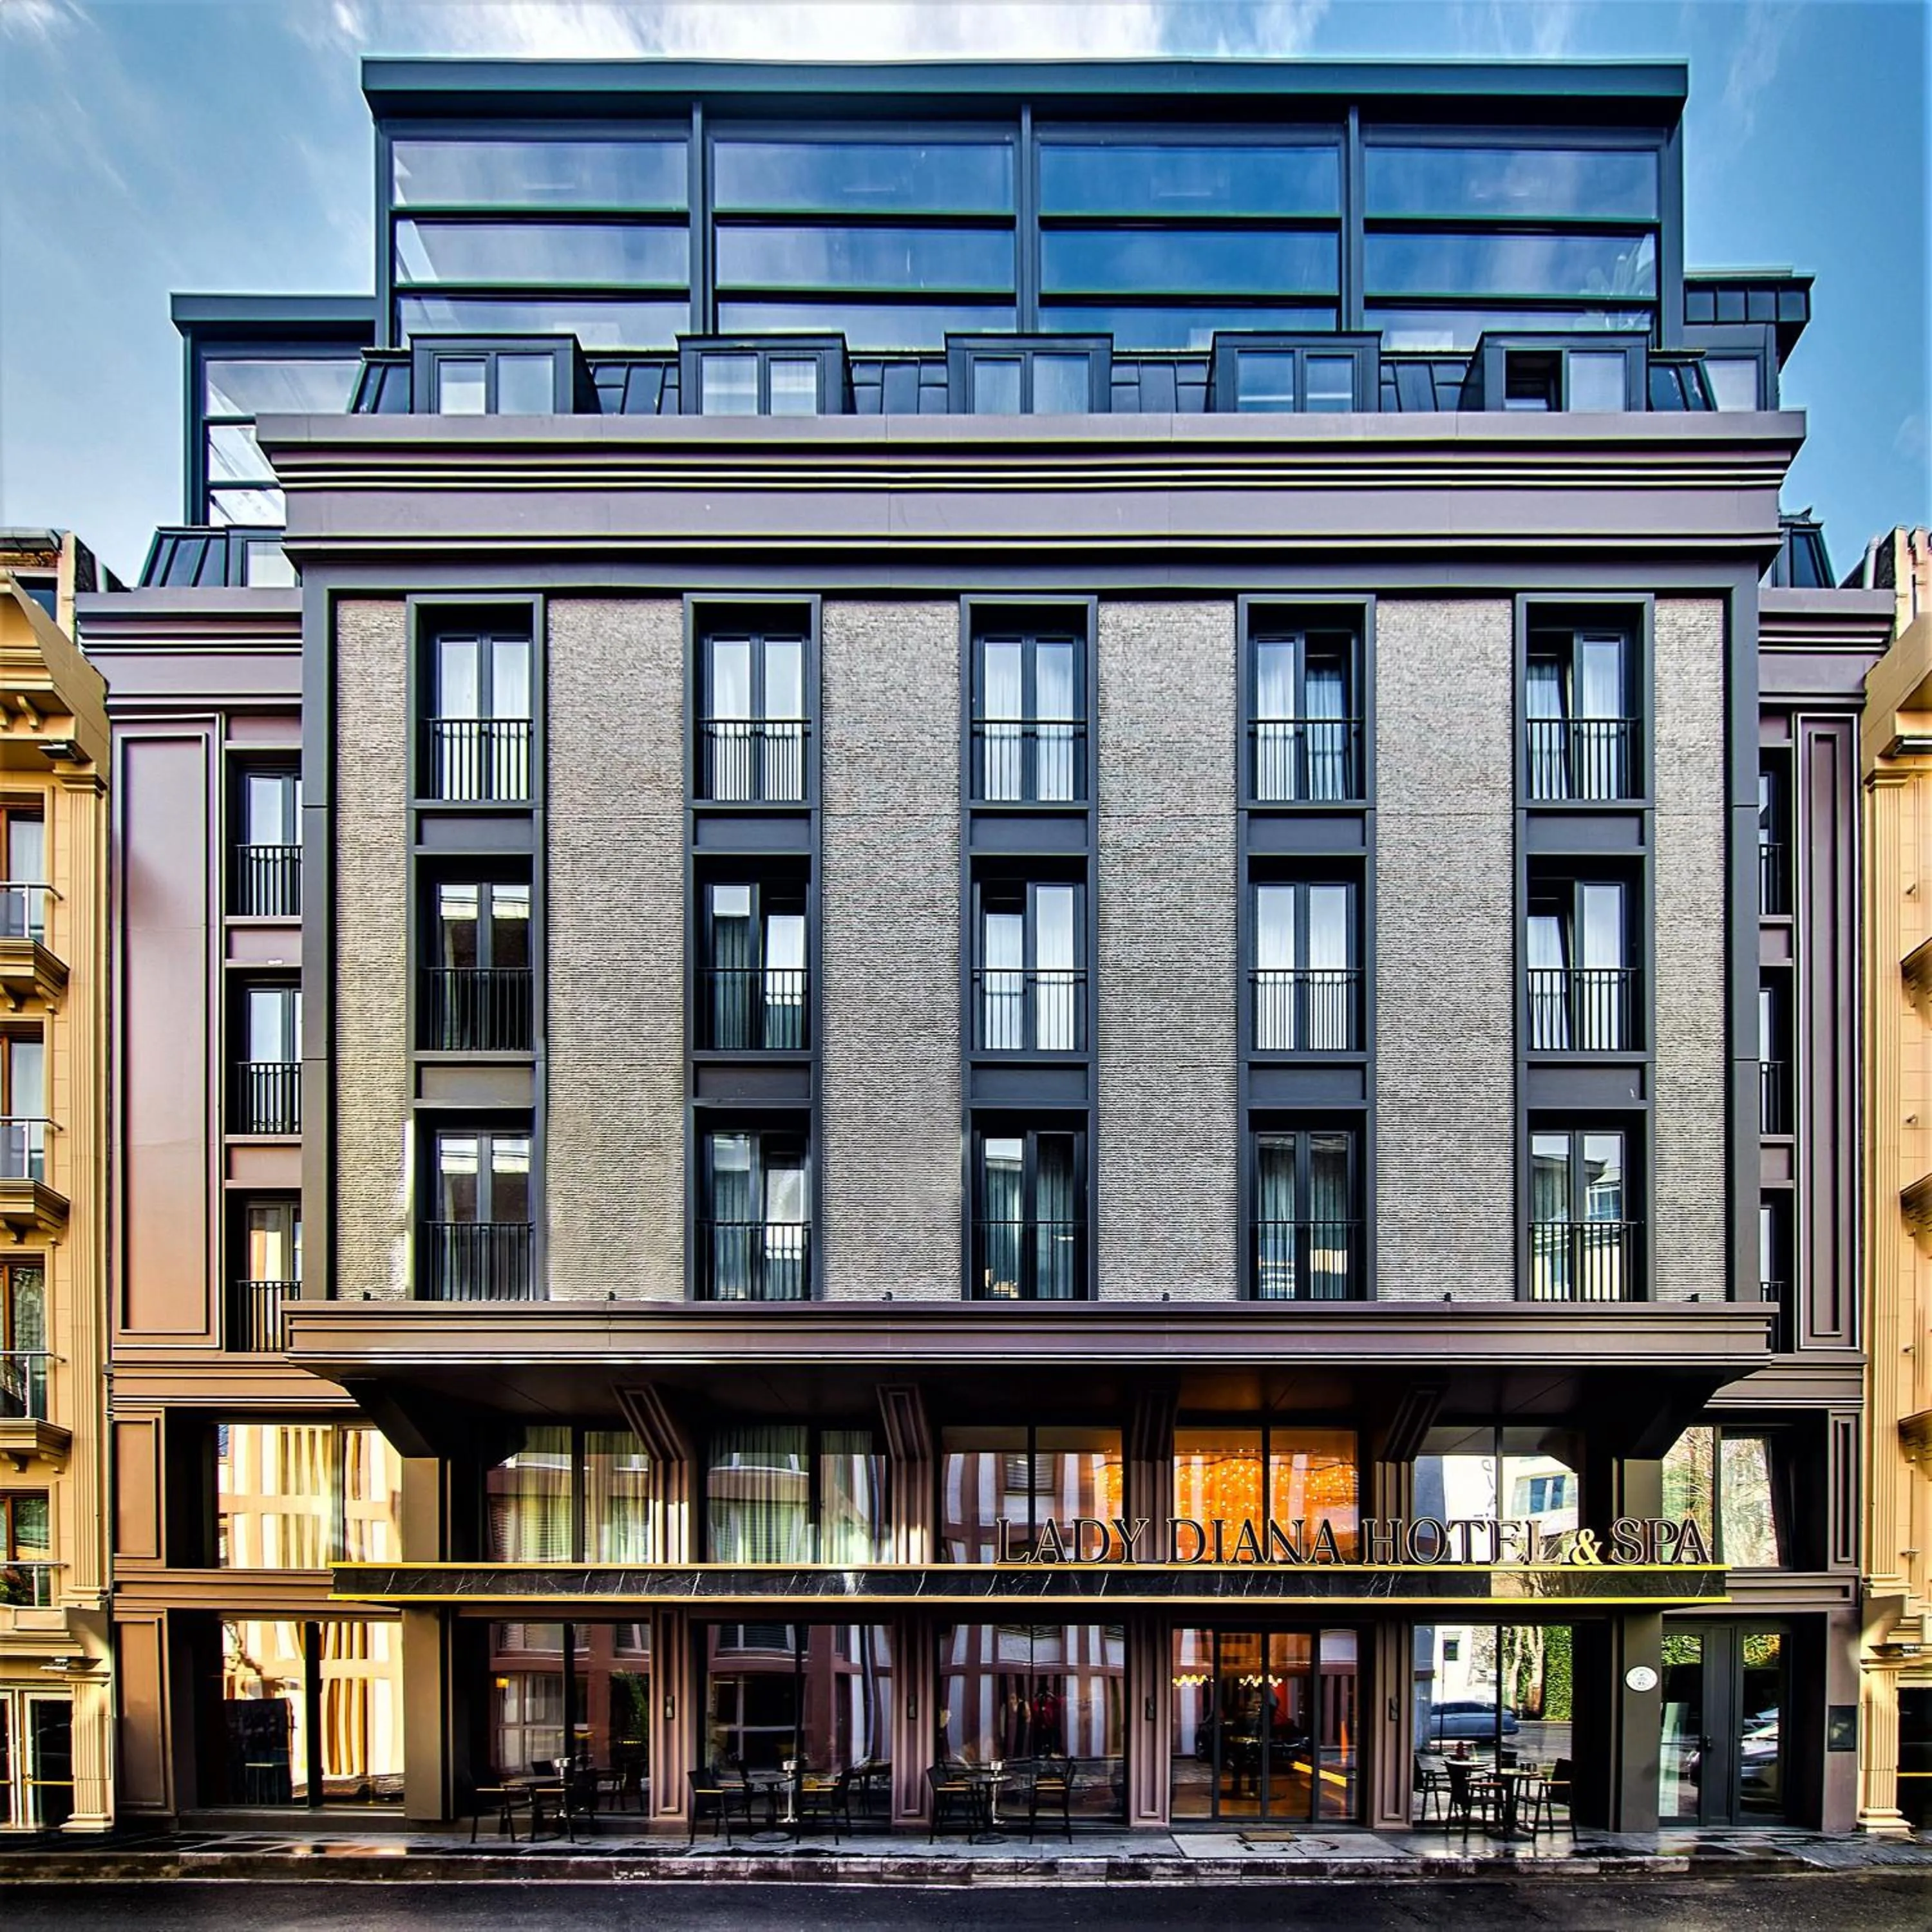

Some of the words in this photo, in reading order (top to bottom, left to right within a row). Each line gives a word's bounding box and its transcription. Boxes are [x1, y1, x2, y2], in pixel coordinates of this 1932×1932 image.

[996, 1517, 1149, 1566] LADY
[1166, 1517, 1345, 1566] DIANA
[1362, 1517, 1562, 1566] HOTEL
[1569, 1528, 1604, 1566] &
[1612, 1516, 1712, 1566] SPA
